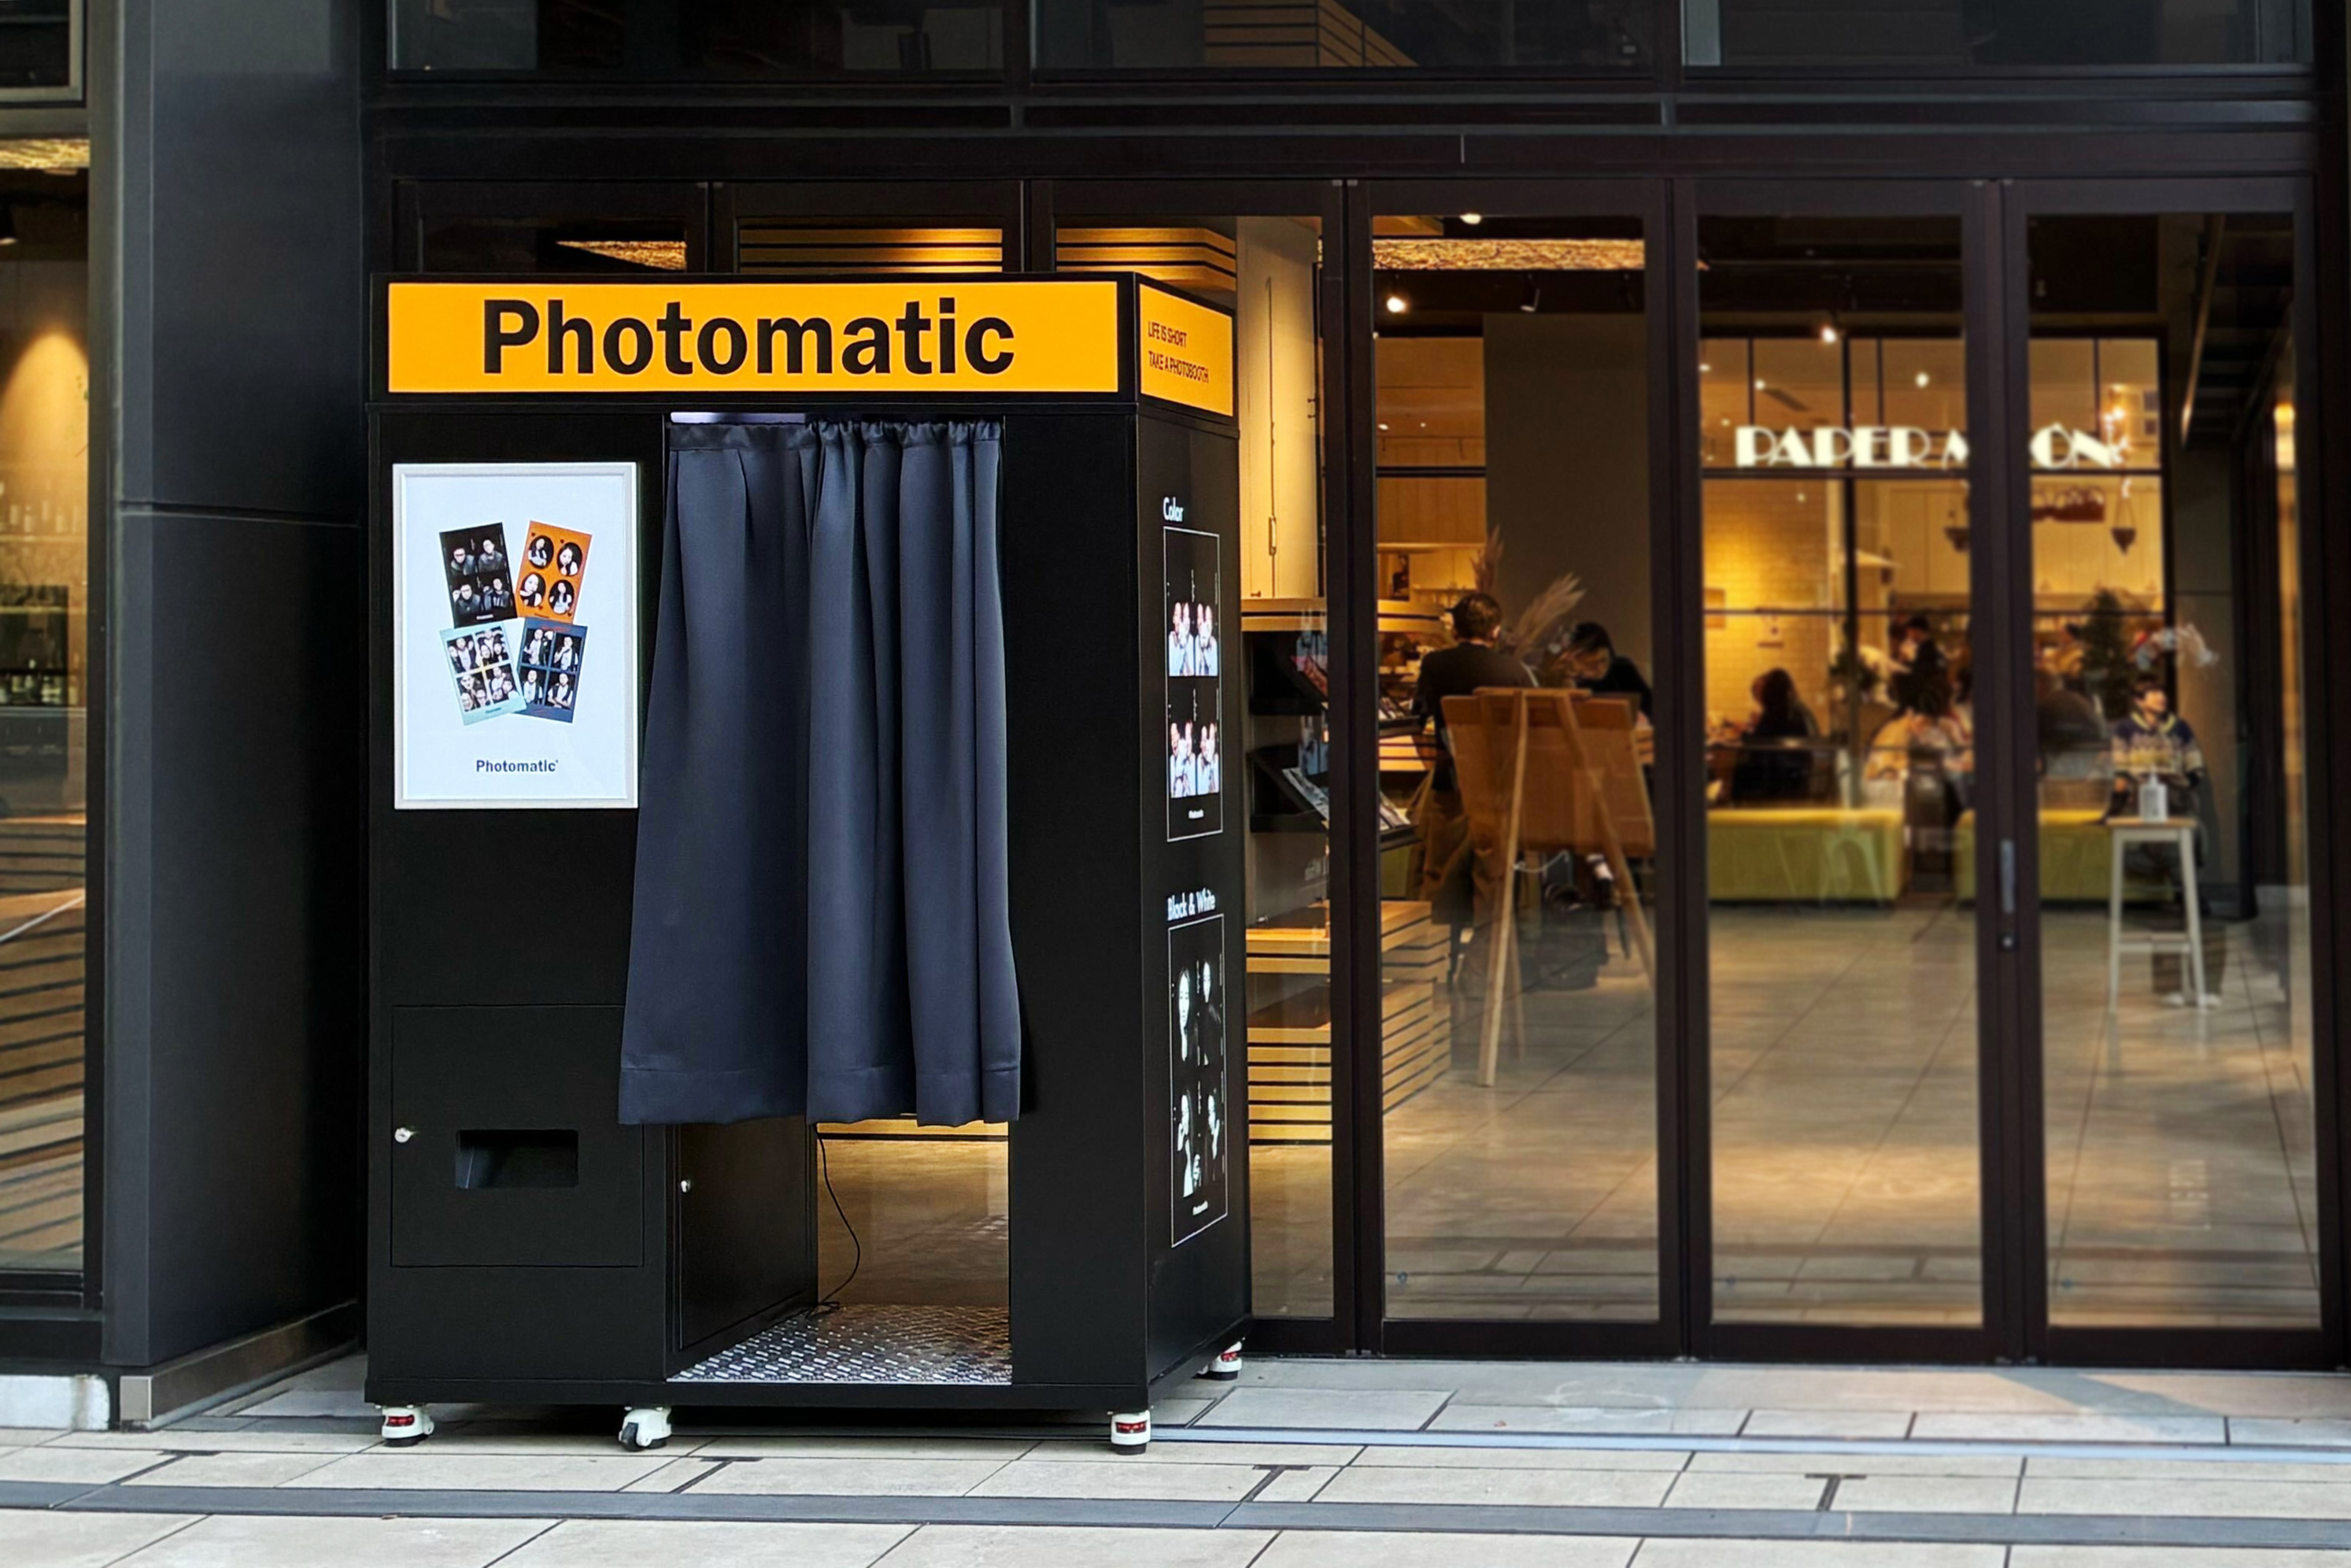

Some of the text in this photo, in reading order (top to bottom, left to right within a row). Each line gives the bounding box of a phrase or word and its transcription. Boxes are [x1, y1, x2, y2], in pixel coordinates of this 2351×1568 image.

[482, 296, 1015, 376] Photomatic
[1167, 327, 1187, 348] SHORT
[1736, 425, 1931, 468] PAPER
[1163, 497, 1184, 522] Color
[1167, 887, 1215, 921] Black & White
